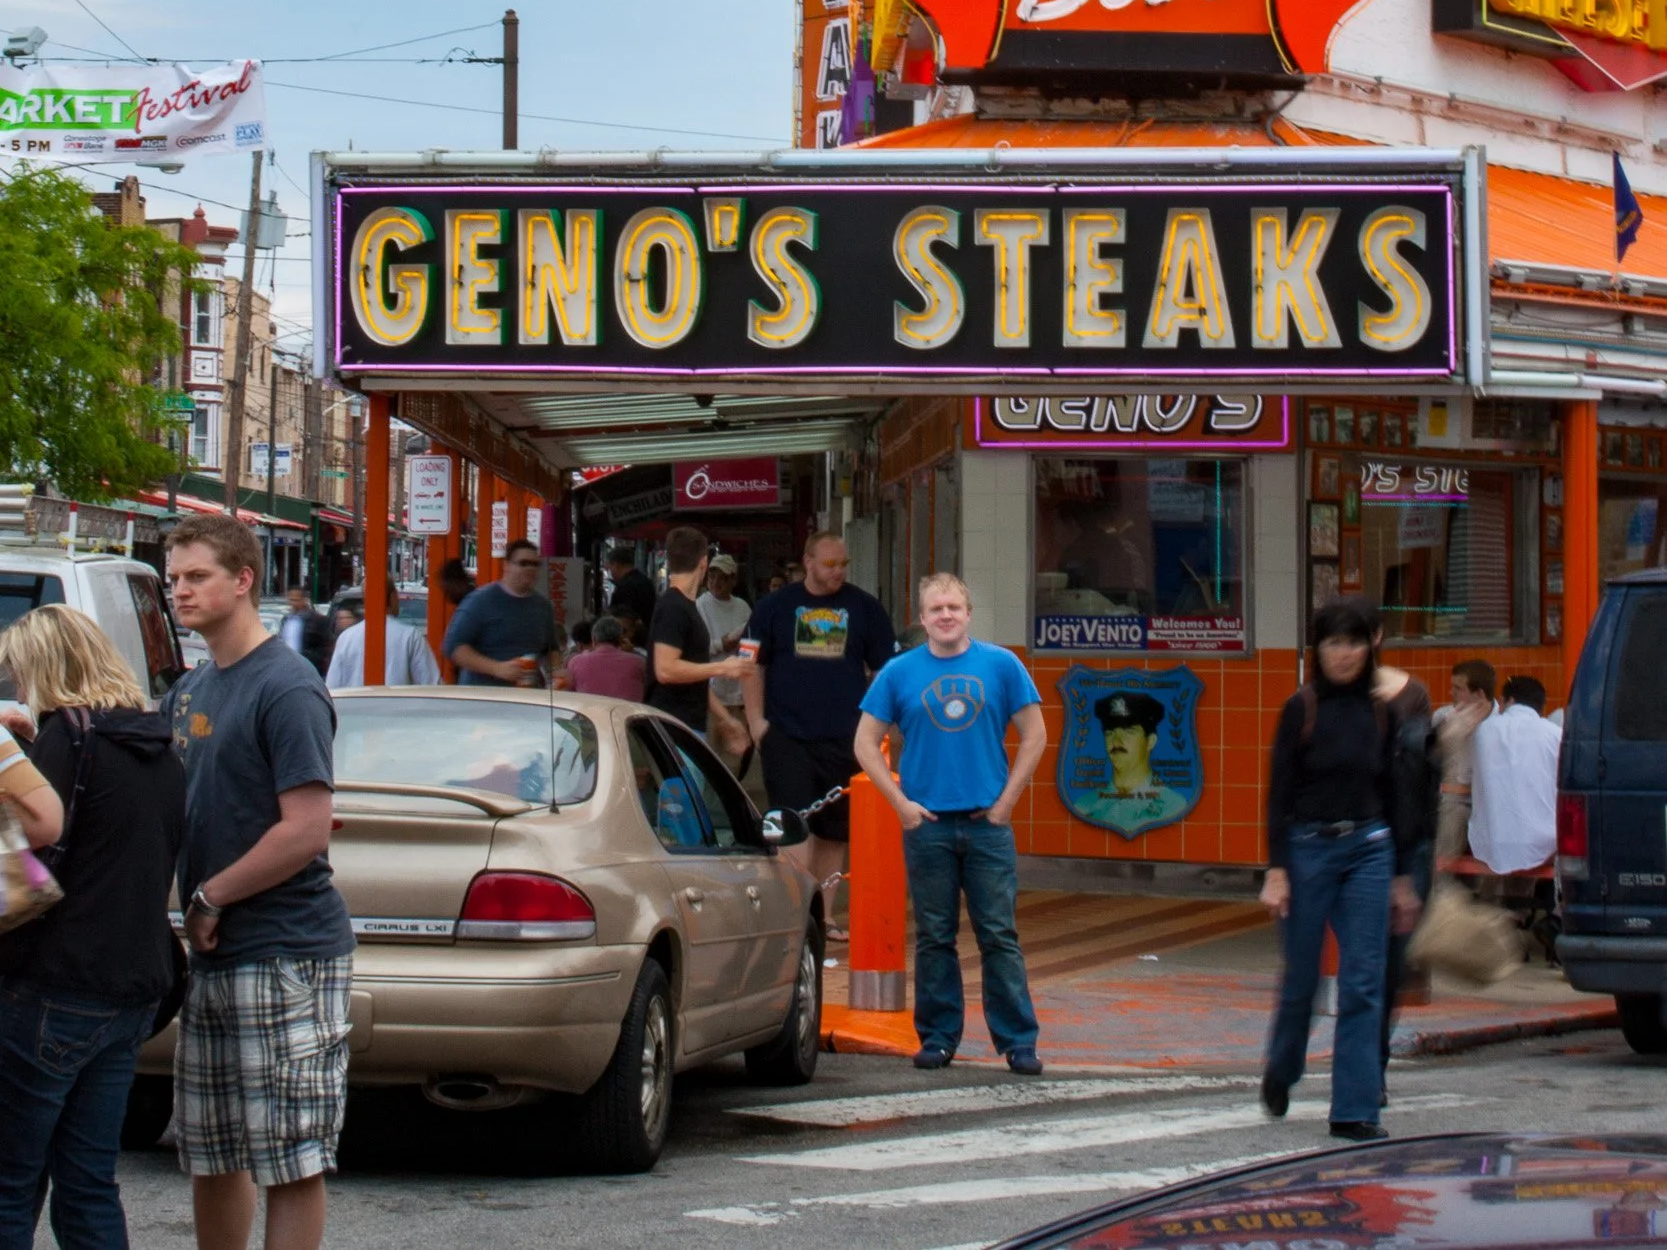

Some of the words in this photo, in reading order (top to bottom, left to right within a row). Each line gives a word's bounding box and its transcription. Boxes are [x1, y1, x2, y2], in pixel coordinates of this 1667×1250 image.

[126, 59, 253, 134] Festival
[12, 139, 21, 152] 5
[27, 140, 51, 152] PM
[349, 196, 822, 350] GENO'S
[893, 204, 1432, 353] STEAKS
[421, 476, 438, 487] ONLY
[1151, 617, 1211, 629] Welcomes
[1214, 617, 1241, 629] You!
[1036, 618, 1082, 646] JOEY
[1081, 618, 1143, 642] VENTO
[364, 922, 419, 932] CIRRUS
[425, 923, 447, 932] LXi
